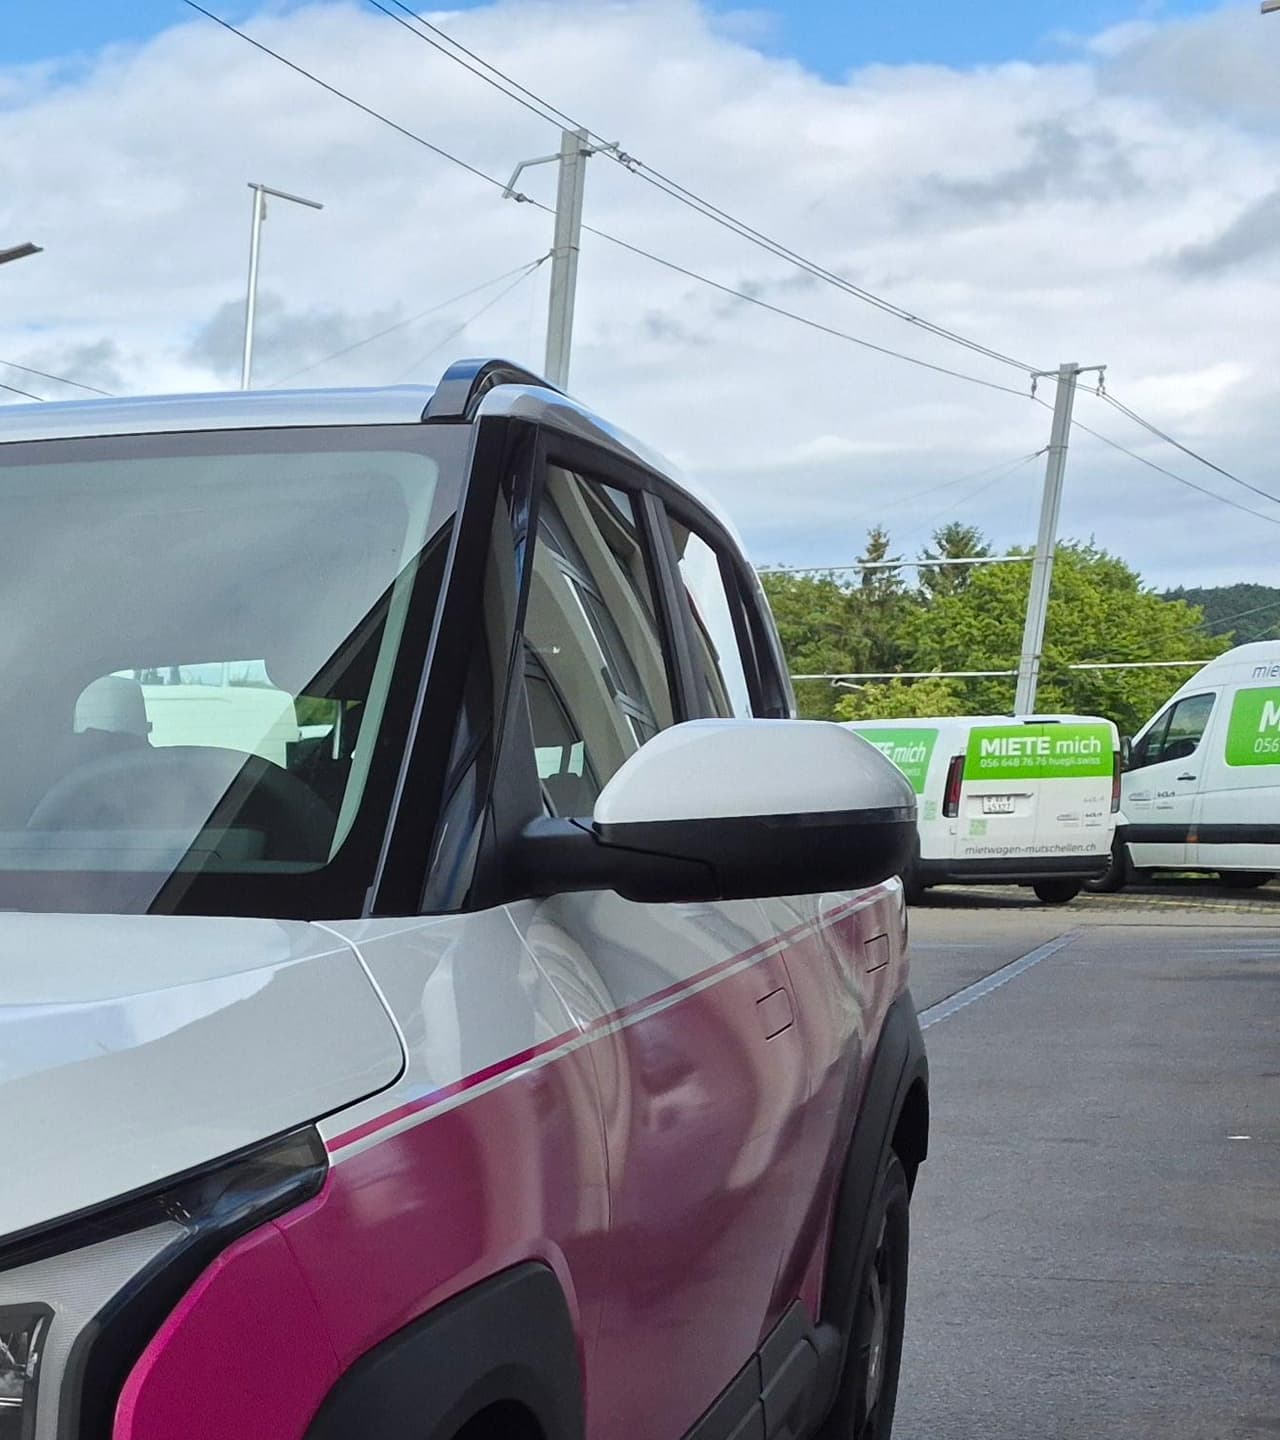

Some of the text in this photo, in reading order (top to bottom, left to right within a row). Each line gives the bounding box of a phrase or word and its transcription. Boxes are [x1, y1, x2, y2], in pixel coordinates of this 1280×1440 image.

[1252, 664, 1280, 678] mie
[892, 741, 927, 763] mich
[980, 735, 1102, 757] MIETE mich
[980, 758, 999, 768] 056
